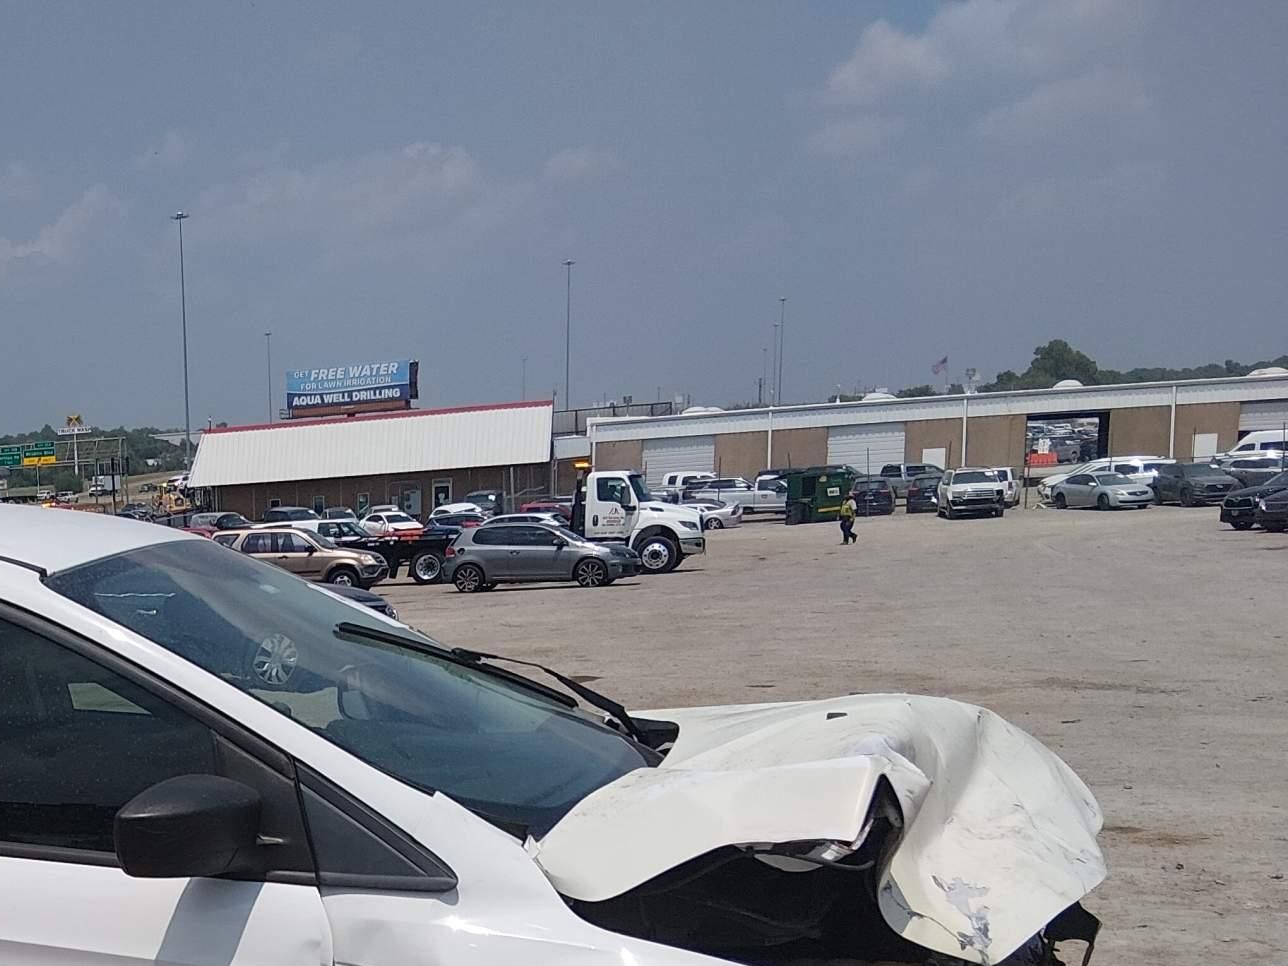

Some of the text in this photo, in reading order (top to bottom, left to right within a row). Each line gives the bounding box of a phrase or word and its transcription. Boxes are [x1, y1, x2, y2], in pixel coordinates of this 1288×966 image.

[294, 362, 398, 380] GET FREE WATER
[300, 375, 391, 392] FOR LAWN IRRIGATION
[292, 388, 400, 406] AQUA WELL DRILLING
